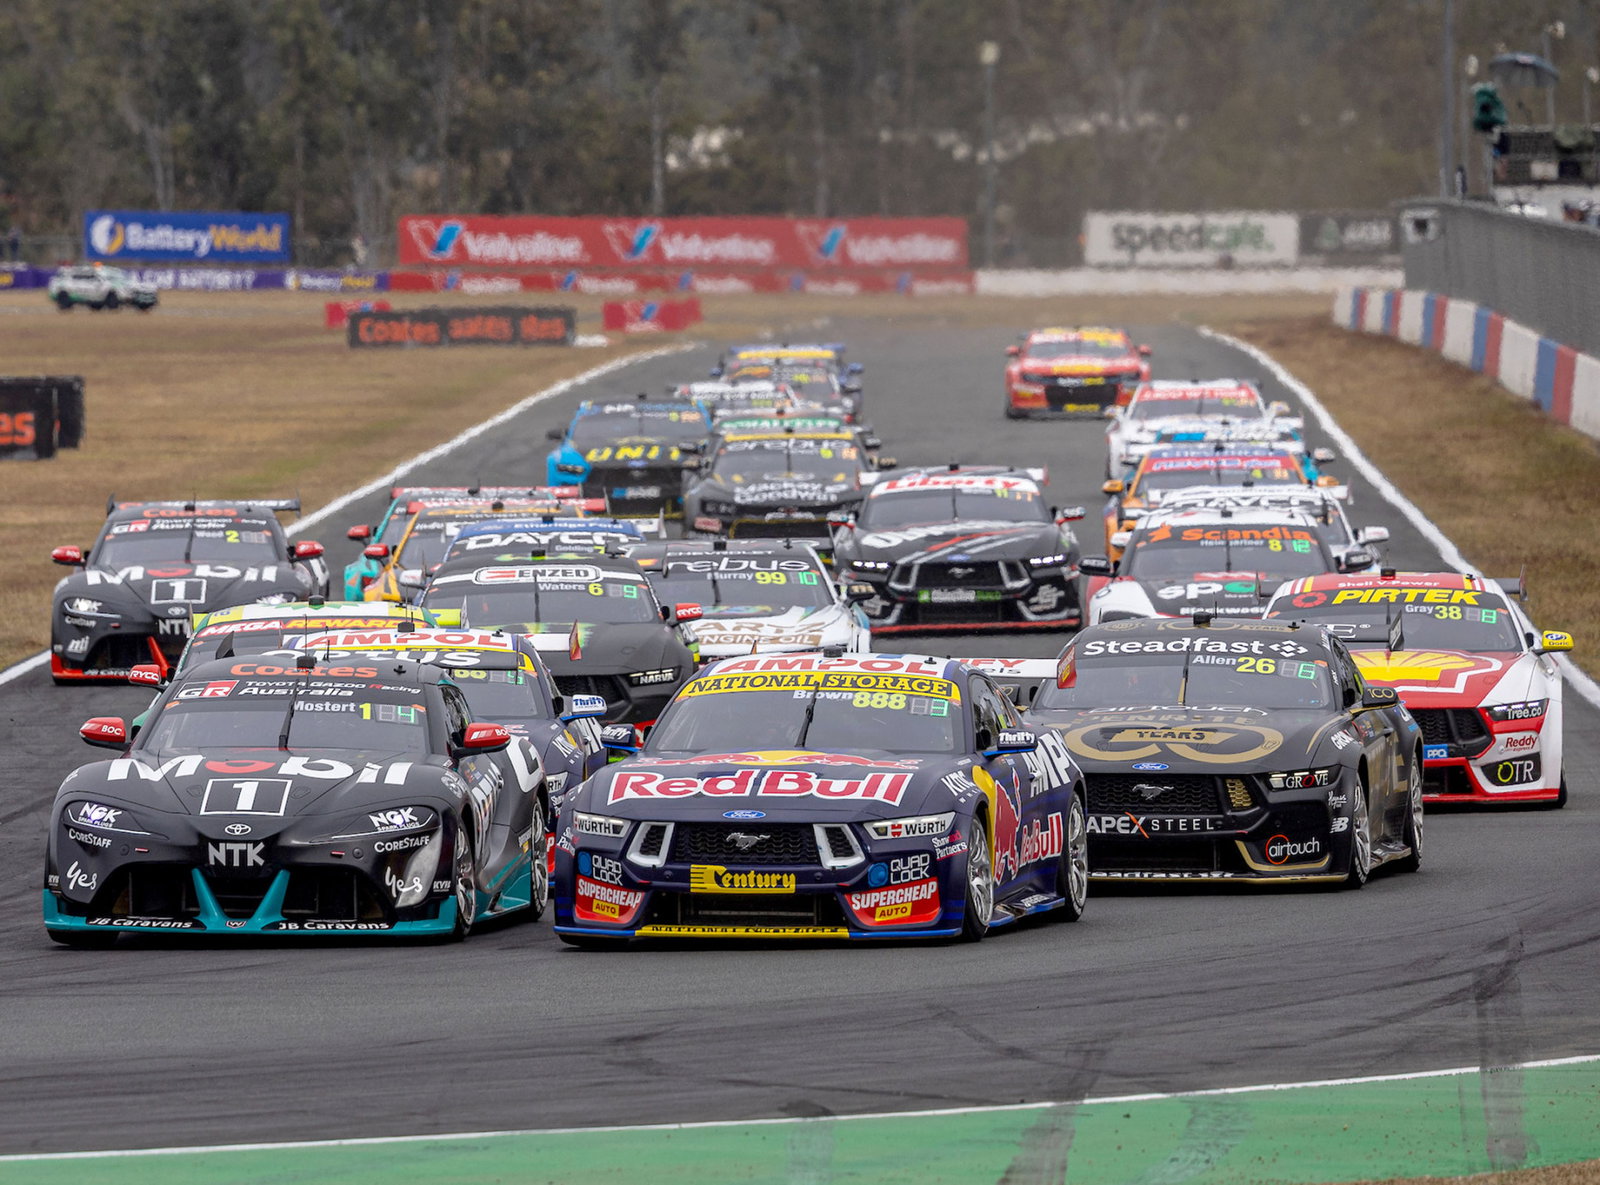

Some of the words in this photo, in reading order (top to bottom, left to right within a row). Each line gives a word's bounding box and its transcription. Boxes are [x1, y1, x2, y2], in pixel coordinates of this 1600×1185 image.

[224, 529, 240, 543] 2
[1181, 527, 1312, 541] Scandia
[86, 564, 279, 586] Mobil
[518, 567, 590, 579] ENZED
[755, 571, 787, 585] 99
[168, 580, 186, 601] 1
[537, 582, 586, 592] Waters
[588, 583, 604, 596] 6
[1332, 588, 1484, 606] PIRTEK
[1404, 603, 1434, 615] Gray
[1434, 605, 1463, 621] 38
[200, 620, 283, 637] MEGA
[300, 633, 509, 648] AMPOL
[778, 634, 816, 645] OIL
[1083, 637, 1266, 657] Steadfast
[716, 658, 938, 676] AMPOL
[1192, 655, 1238, 667] Allen
[1236, 656, 1276, 675] 26
[230, 663, 378, 678] Coates
[639, 672, 675, 686] NARVA
[177, 685, 232, 698] GR
[238, 687, 355, 697] Australia
[369, 683, 422, 695] Racing
[688, 674, 820, 695] NATIONAL
[825, 674, 949, 696] STORAGE
[793, 687, 854, 701] Brown
[852, 691, 907, 710] 888
[293, 701, 357, 713] Mostert
[359, 702, 372, 720] 1
[1507, 707, 1542, 720] Tree.co
[101, 724, 123, 736] BOC
[999, 731, 1036, 744] Thrifty
[1505, 735, 1538, 749] Reddy
[107, 754, 414, 786] Mobil
[1498, 760, 1534, 783] OTR
[607, 768, 756, 806] Red
[756, 767, 914, 807] Bull
[1285, 773, 1329, 789] GROVE
[232, 781, 261, 811] 1
[79, 801, 122, 823] NGK
[368, 806, 418, 827] NGK
[577, 818, 612, 835] WÜRTH
[904, 819, 947, 836] WÜRTH
[1086, 812, 1150, 838] APEX
[1151, 818, 1215, 831] STEEL
[208, 841, 266, 867] NTK
[935, 840, 968, 859] Partners
[1268, 836, 1320, 858] airtouch
[592, 854, 623, 875] QUAD
[890, 853, 931, 873] QUAD
[592, 867, 623, 887] LOCK
[890, 864, 931, 885] LOCK
[578, 878, 642, 909] SUPERCHEAP
[851, 881, 938, 911] SUPERCHEAP
[595, 903, 616, 915] AUTO
[879, 905, 908, 918] AUTO
[89, 917, 108, 926] JB
[108, 917, 193, 929] Caravans
[278, 921, 300, 931] JB
[303, 921, 390, 931] Caravans
